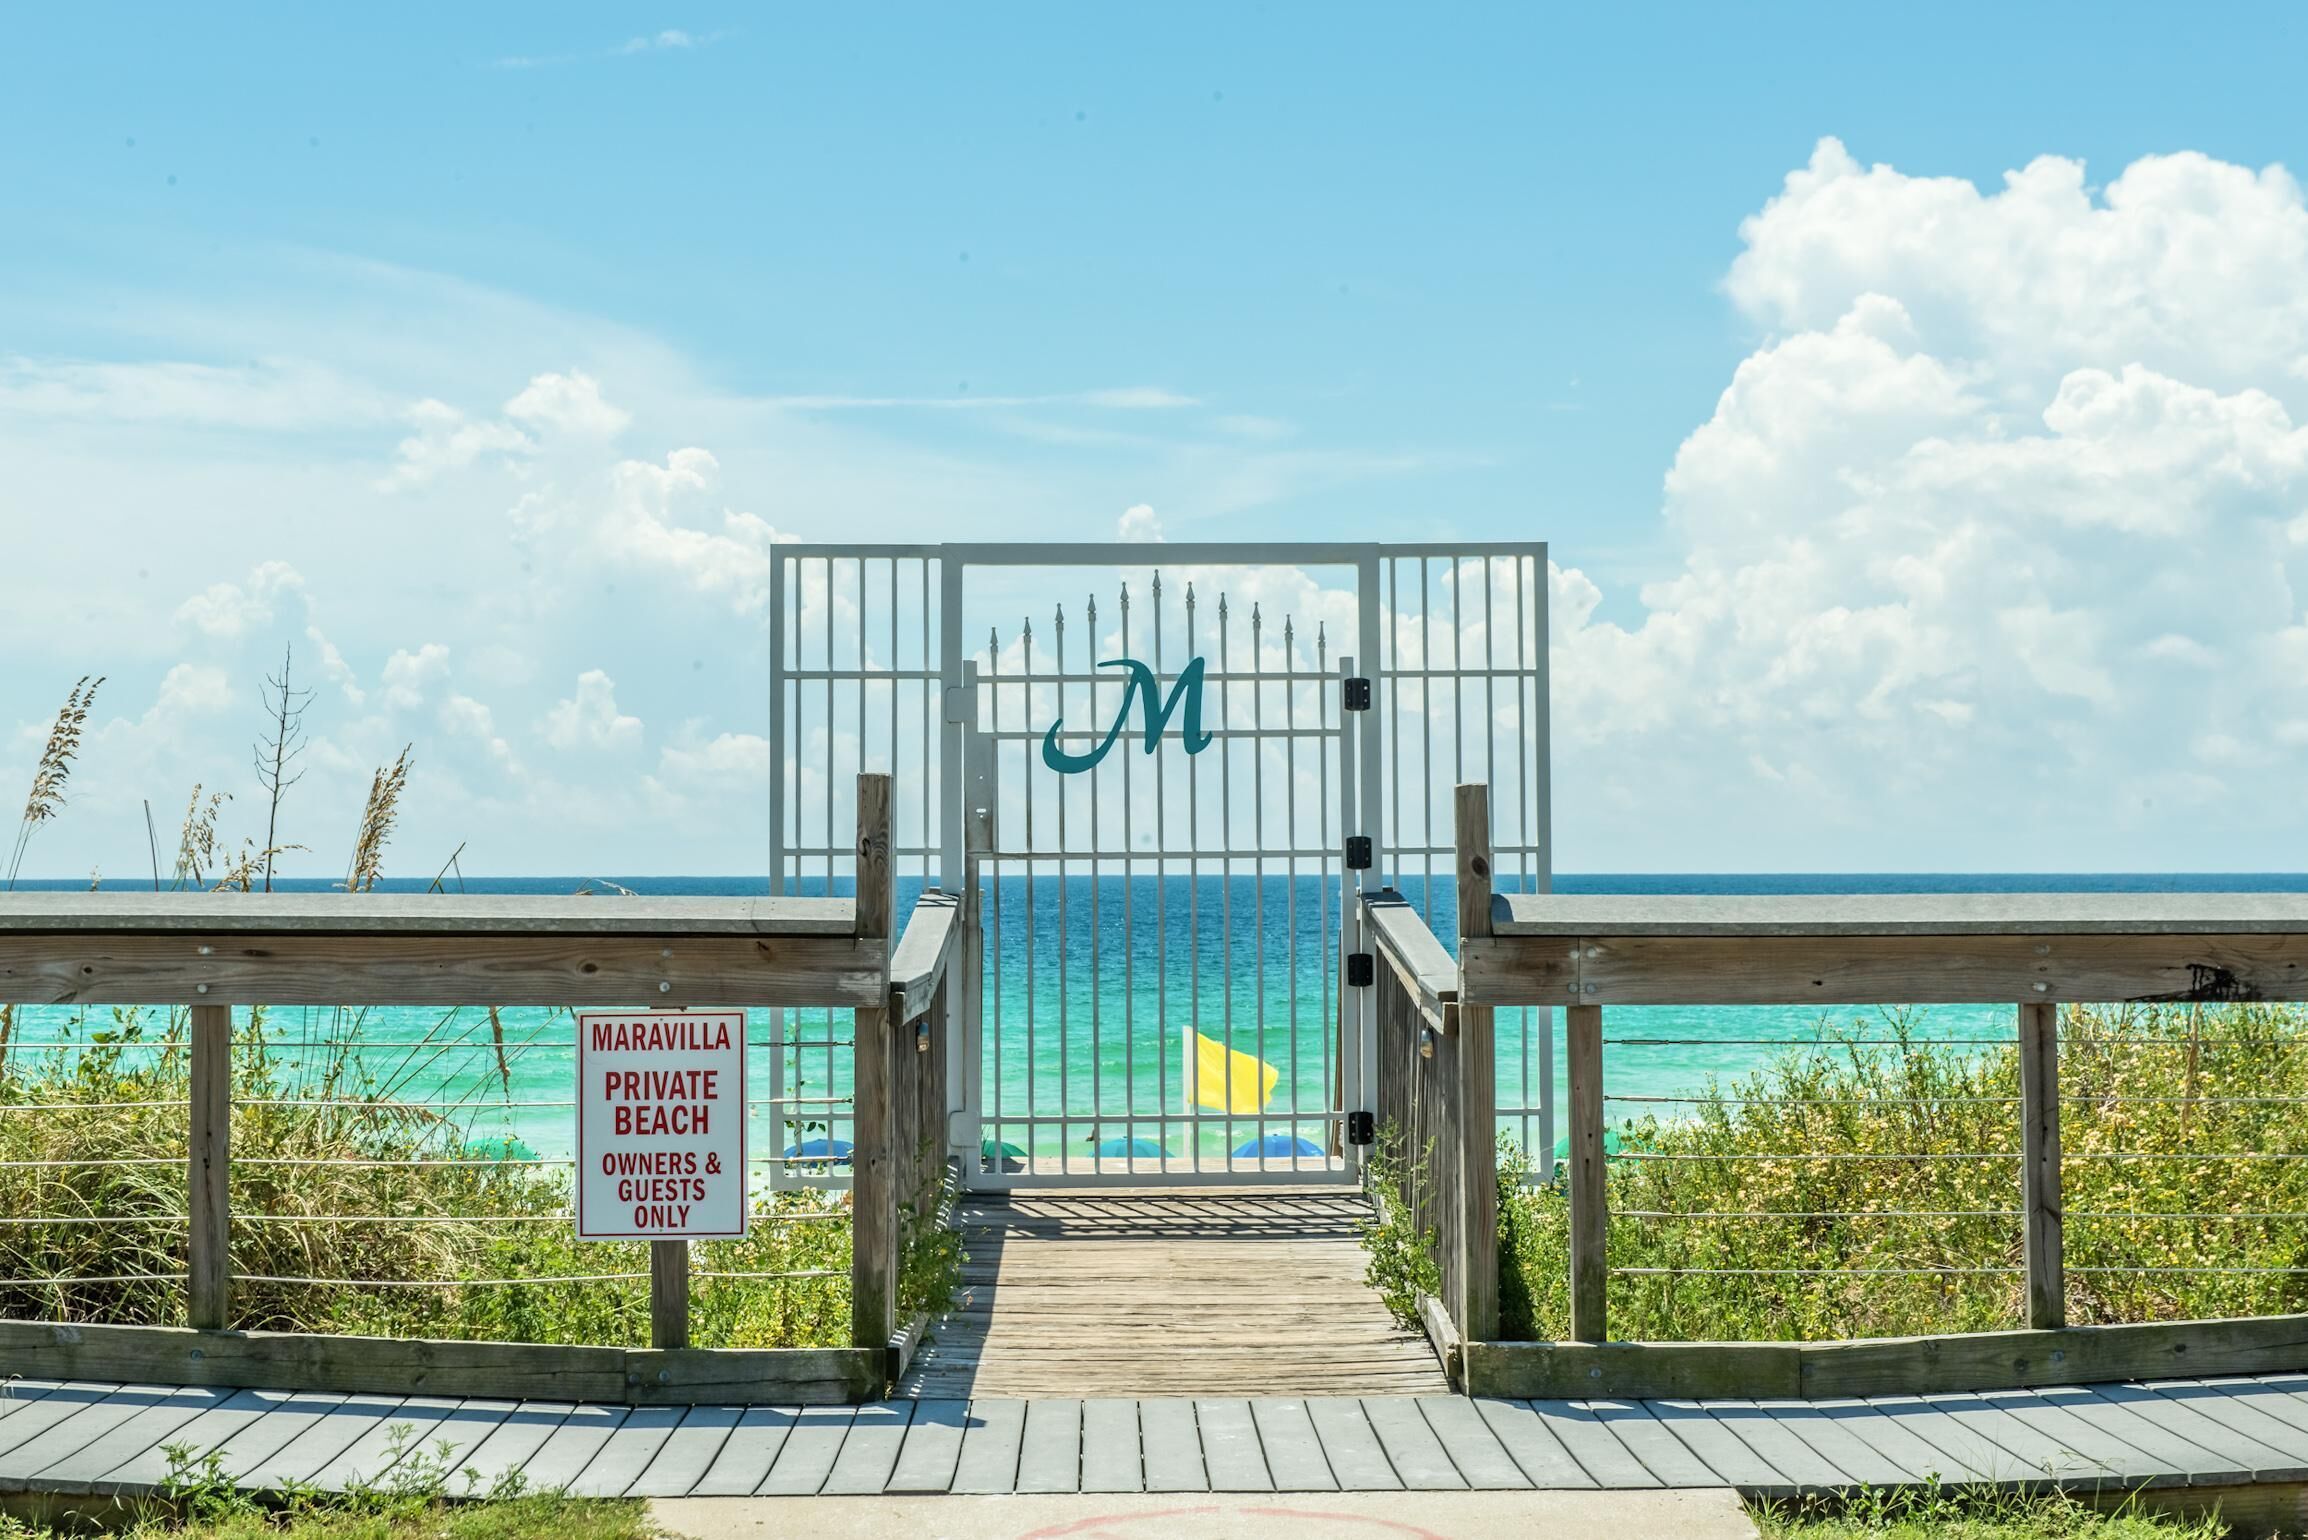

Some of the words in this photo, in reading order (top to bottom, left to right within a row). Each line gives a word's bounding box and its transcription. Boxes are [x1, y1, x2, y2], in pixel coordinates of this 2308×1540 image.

[1042, 656, 1213, 774] M
[592, 1022, 731, 1051] MARAVILLA
[605, 1070, 718, 1100] PRIVATE
[615, 1105, 709, 1135] BEACH
[602, 1152, 697, 1176] OWNERS
[705, 1151, 722, 1175] &
[618, 1178, 706, 1202] GUESTS
[634, 1205, 690, 1228] ONLY
